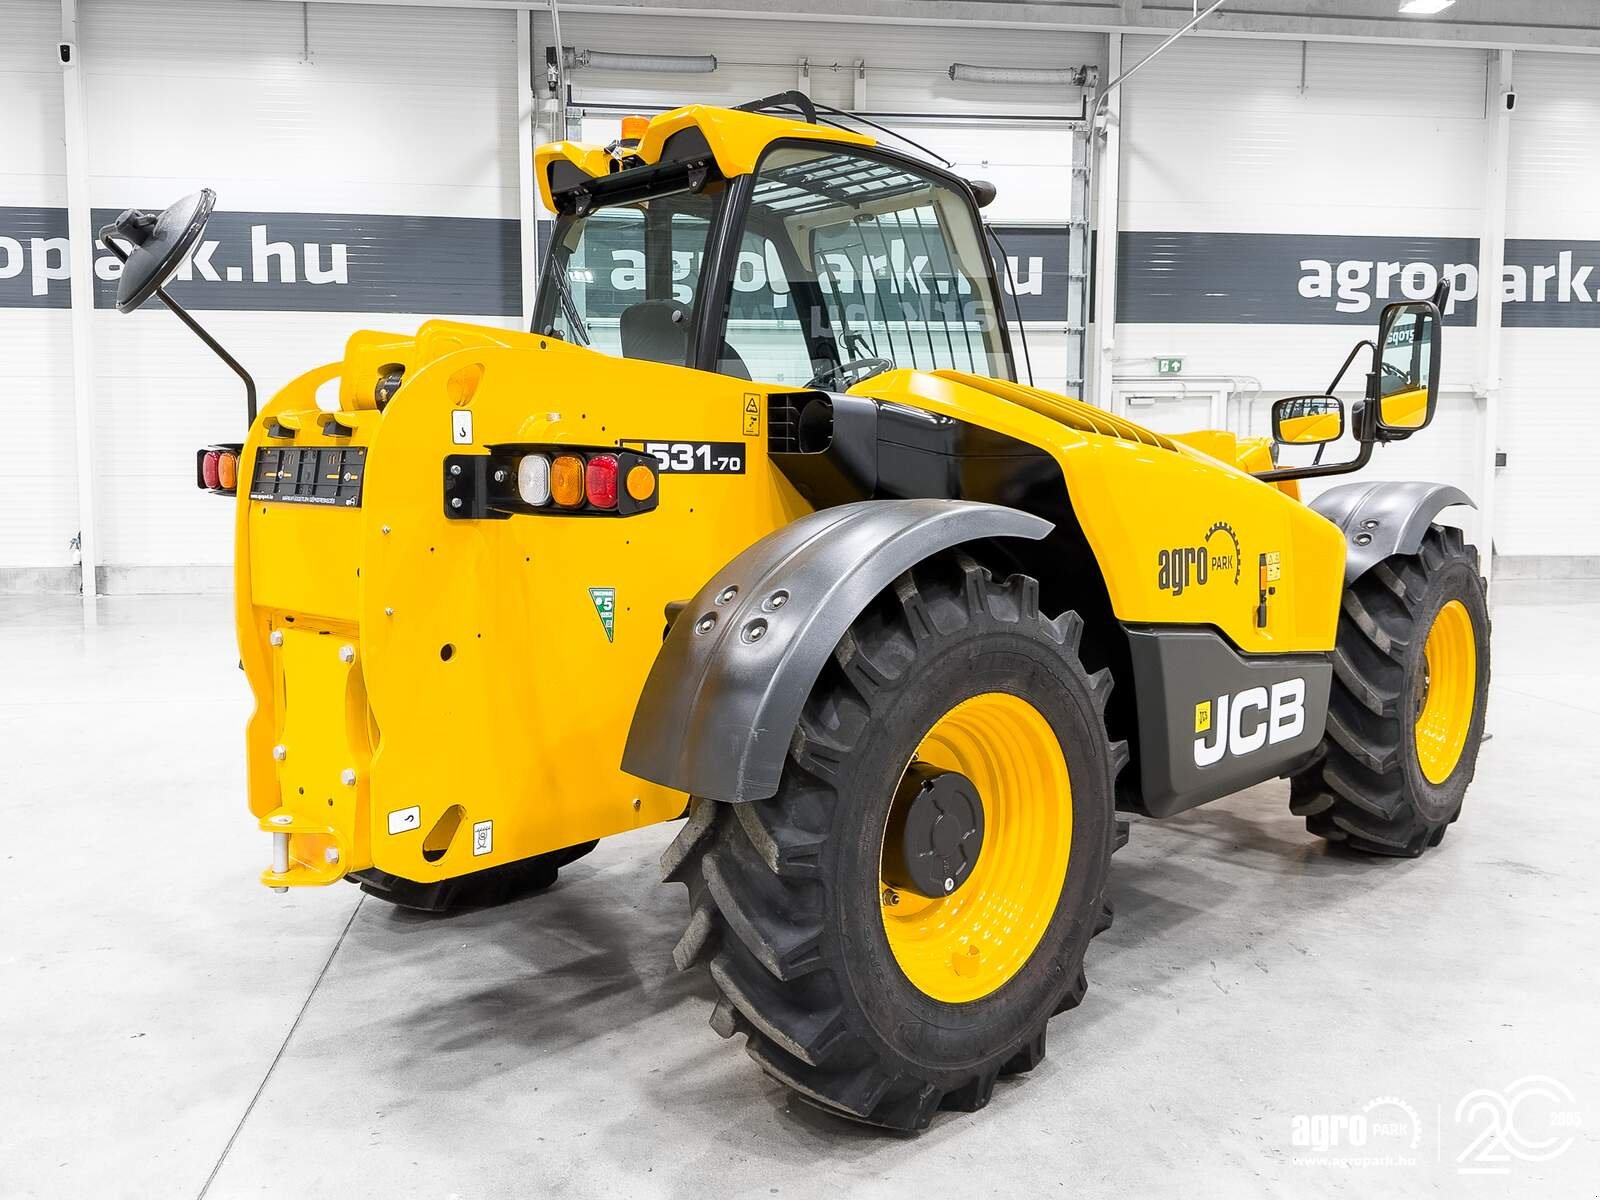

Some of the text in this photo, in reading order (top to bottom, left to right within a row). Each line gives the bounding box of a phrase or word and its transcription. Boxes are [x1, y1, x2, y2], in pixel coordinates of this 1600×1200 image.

[1298, 250, 1600, 316] agropark
[646, 443, 740, 471] 531-70
[1159, 546, 1233, 596] agro PARK
[1194, 677, 1305, 767] JCB
